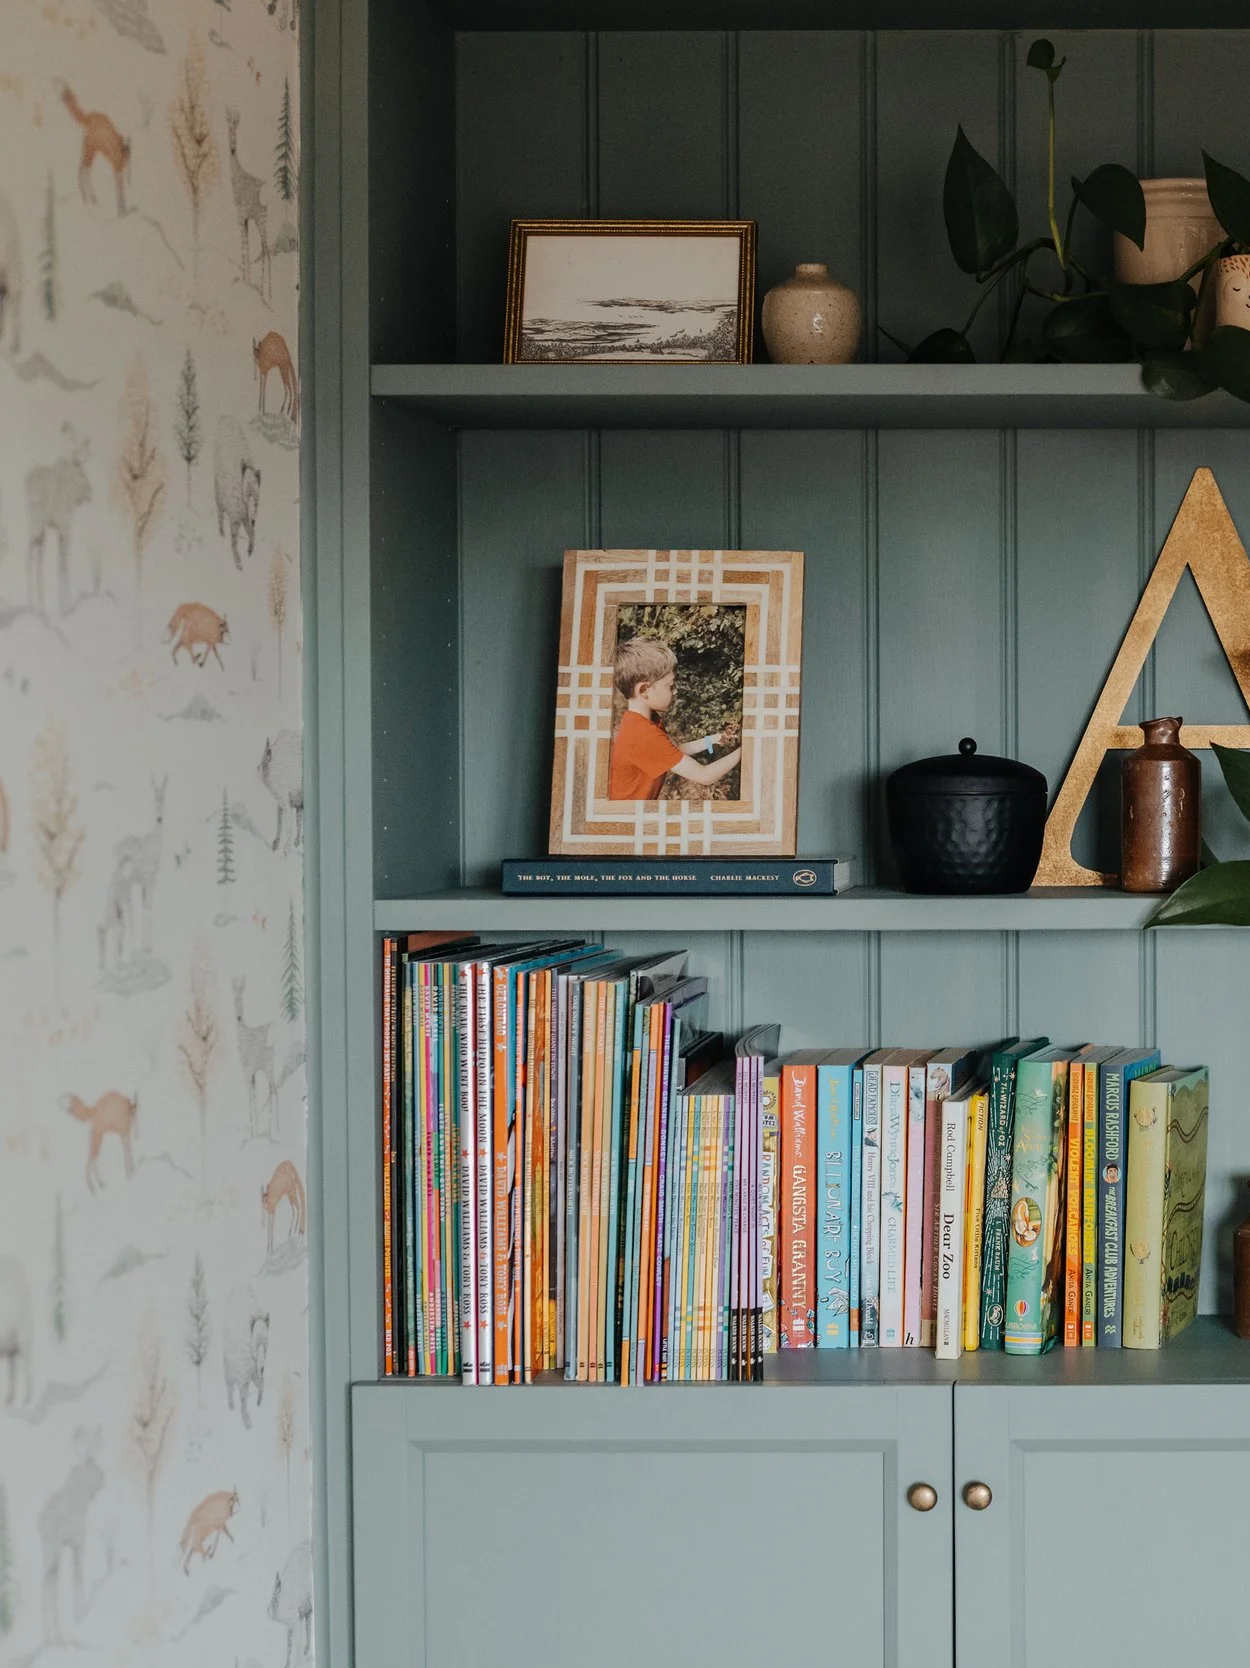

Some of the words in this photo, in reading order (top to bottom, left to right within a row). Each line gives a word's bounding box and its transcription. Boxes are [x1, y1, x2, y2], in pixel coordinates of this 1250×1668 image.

[460, 982, 468, 1001] THE
[478, 982, 487, 1001] THE
[460, 1004, 468, 1029] BEAR
[478, 1006, 487, 1033] FIRST
[496, 984, 507, 1036] GERONIMO
[460, 1033, 468, 1057] WHO
[478, 1039, 487, 1069] HIPPO
[460, 1060, 468, 1088] WENT
[478, 1072, 487, 1085] ON
[868, 1073, 878, 1092] DEAD
[460, 1091, 468, 1112] BOO!
[478, 1090, 487, 1110] THE
[792, 1075, 806, 1108] David
[1106, 1073, 1120, 1110] MARCUS
[868, 1094, 878, 1124] FAMOUS
[478, 1114, 487, 1143] MOON
[792, 1110, 806, 1158] Walliams
[946, 1123, 956, 1141] Rod
[998, 1135, 1005, 1146] OZ
[1106, 1113, 1120, 1160] RASHFORD
[866, 1152, 874, 1172] Henry
[944, 1145, 955, 1191] Campbell
[1070, 1137, 1079, 1184] VIOLENT
[462, 1166, 470, 1197] DAVID
[480, 1165, 488, 1195] DAVID
[496, 1166, 507, 1197] DAVID
[762, 1154, 771, 1203] RANDOM
[792, 1165, 806, 1234] GANGSTA
[866, 1190, 874, 1202] and
[462, 1200, 470, 1250] WALLIAMS
[480, 1199, 488, 1250] WALLIAMS
[496, 1200, 507, 1252] WALLIAMS
[762, 1210, 770, 1235] ACTS
[865, 1214, 873, 1245] Chopping
[943, 1214, 954, 1249] Dear
[1068, 1189, 1078, 1255] VOLCANOES
[1085, 1188, 1094, 1263] RAINFORESTS
[1104, 1195, 1118, 1240] BREAKFAST
[887, 1217, 897, 1268] CHARMED
[1104, 1242, 1118, 1265] CLUB
[462, 1264, 470, 1289] TONY
[480, 1264, 488, 1288] TONY
[496, 1265, 507, 1289] TONY
[792, 1240, 806, 1309] GRANNY
[824, 1250, 842, 1283] BOY
[943, 1253, 954, 1279] Zoo
[1068, 1269, 1076, 1288] ANITA
[1085, 1268, 1093, 1288] ANITA
[887, 1270, 897, 1294] LIFE
[1104, 1267, 1118, 1318] ADVENTURES
[462, 1292, 470, 1315] ROSS
[480, 1293, 488, 1314] ROSS
[496, 1293, 507, 1315] ROSS
[1068, 1291, 1076, 1316] GANERI
[1085, 1291, 1093, 1315] GANERI
